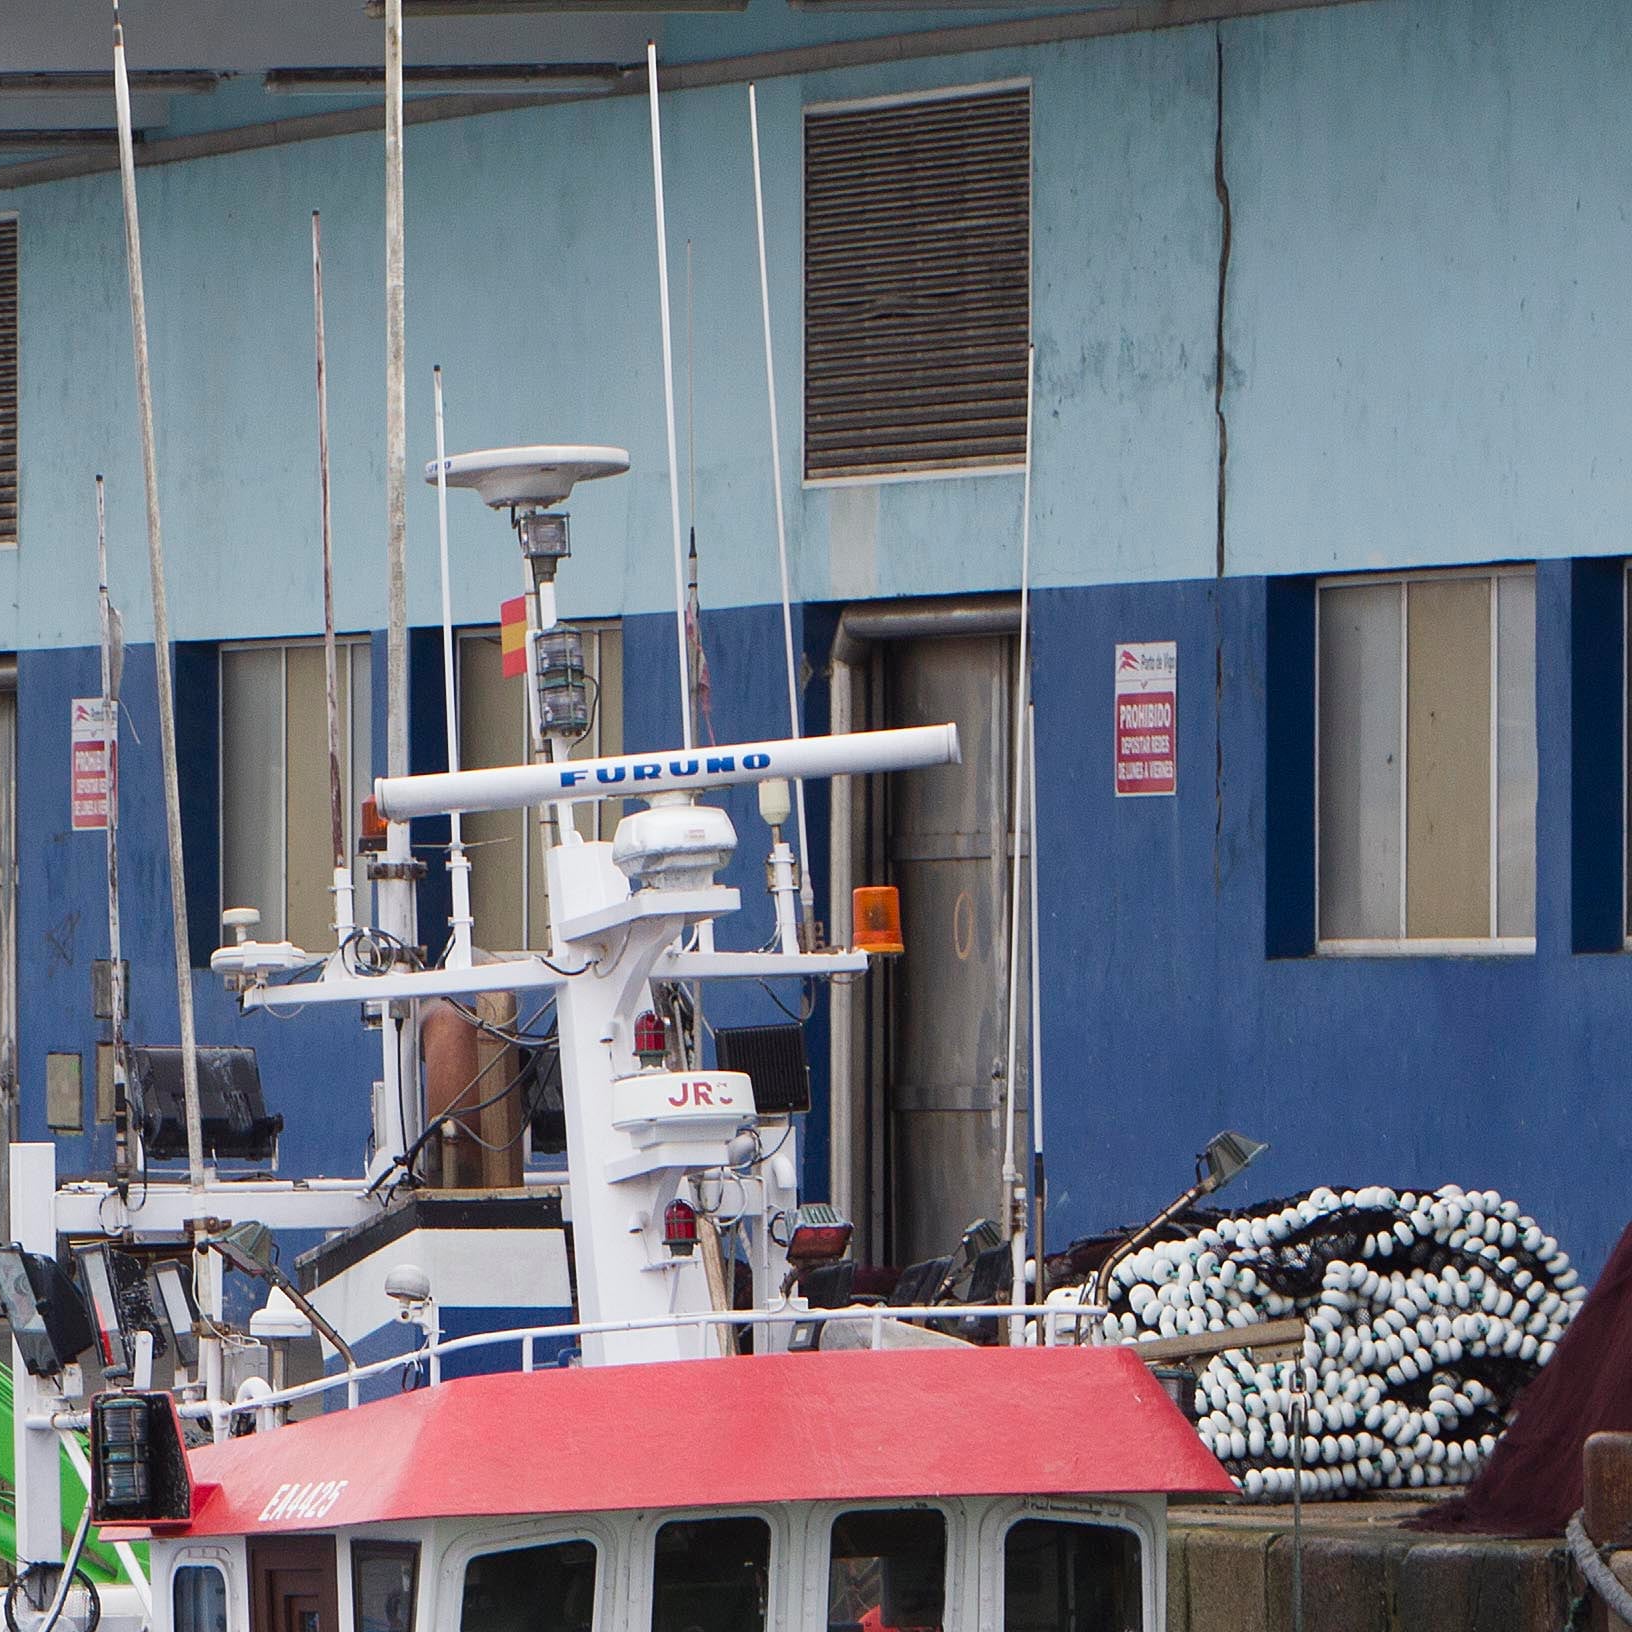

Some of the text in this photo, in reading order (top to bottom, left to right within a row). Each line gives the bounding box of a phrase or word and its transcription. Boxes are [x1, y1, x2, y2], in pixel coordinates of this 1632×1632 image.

[1119, 702, 1171, 730] PROHIBIDO
[560, 753, 771, 787] FURUNO
[258, 1480, 349, 1521] EA4425
